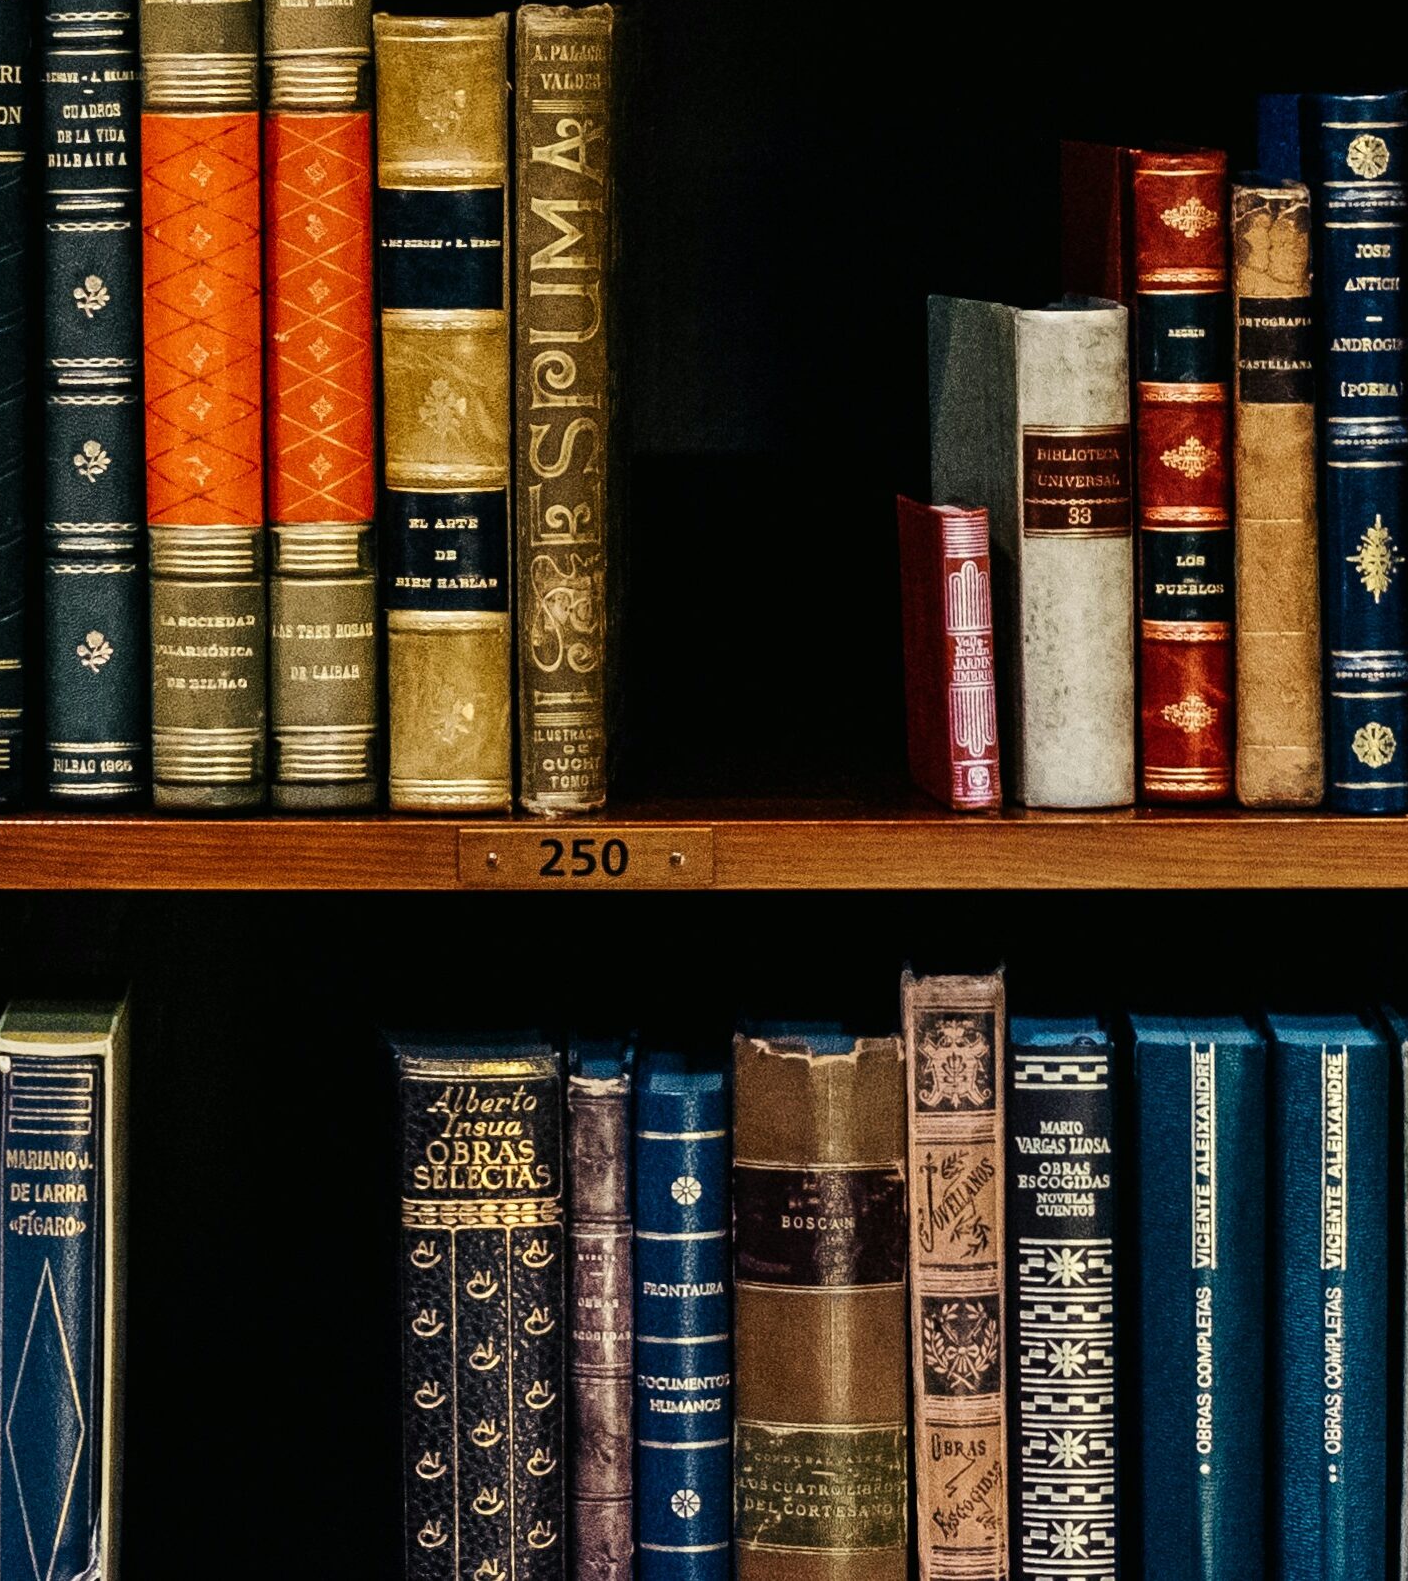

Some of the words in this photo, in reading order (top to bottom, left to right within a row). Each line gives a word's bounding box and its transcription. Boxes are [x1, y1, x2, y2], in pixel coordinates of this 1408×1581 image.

[48, 151, 128, 168] BILBAINA
[1355, 243, 1392, 260] JOSE
[1037, 447, 1121, 463] BIBLIOTECA
[1037, 473, 1120, 488] UNIVERSAL
[409, 517, 429, 530] EL
[433, 516, 479, 530] ARTE
[1067, 506, 1092, 525] 33
[435, 549, 458, 561] DE
[1176, 555, 1205, 567] LOS
[539, 839, 629, 877] 250
[426, 1084, 538, 1114] Alberto
[440, 1113, 523, 1138] Insua
[1195, 1051, 1210, 1182] ALEIXANDRE
[1327, 1053, 1343, 1182] ALEIXANDRE
[1039, 1120, 1083, 1136] MARIO
[425, 1140, 536, 1166] OBRAS
[413, 1164, 552, 1191] SELECTAS
[1038, 1162, 1091, 1176] OBRAS
[1017, 1174, 1111, 1190] ESCOGIDAS
[10, 1183, 31, 1203] DE
[34, 1182, 88, 1203] LARRA
[1036, 1192, 1095, 1204] NOVELAS
[1035, 1203, 1095, 1217] CUENTOS
[1193, 1185, 1209, 1269] VICENTE
[1326, 1185, 1342, 1270] VICENTE
[642, 1281, 724, 1298] FRONTAURA
[1196, 1286, 1212, 1391] COMPLETAS
[1326, 1286, 1342, 1390] COMPLETAS
[1196, 1394, 1212, 1455] OBRAS
[1327, 1393, 1343, 1455] OBRAS
